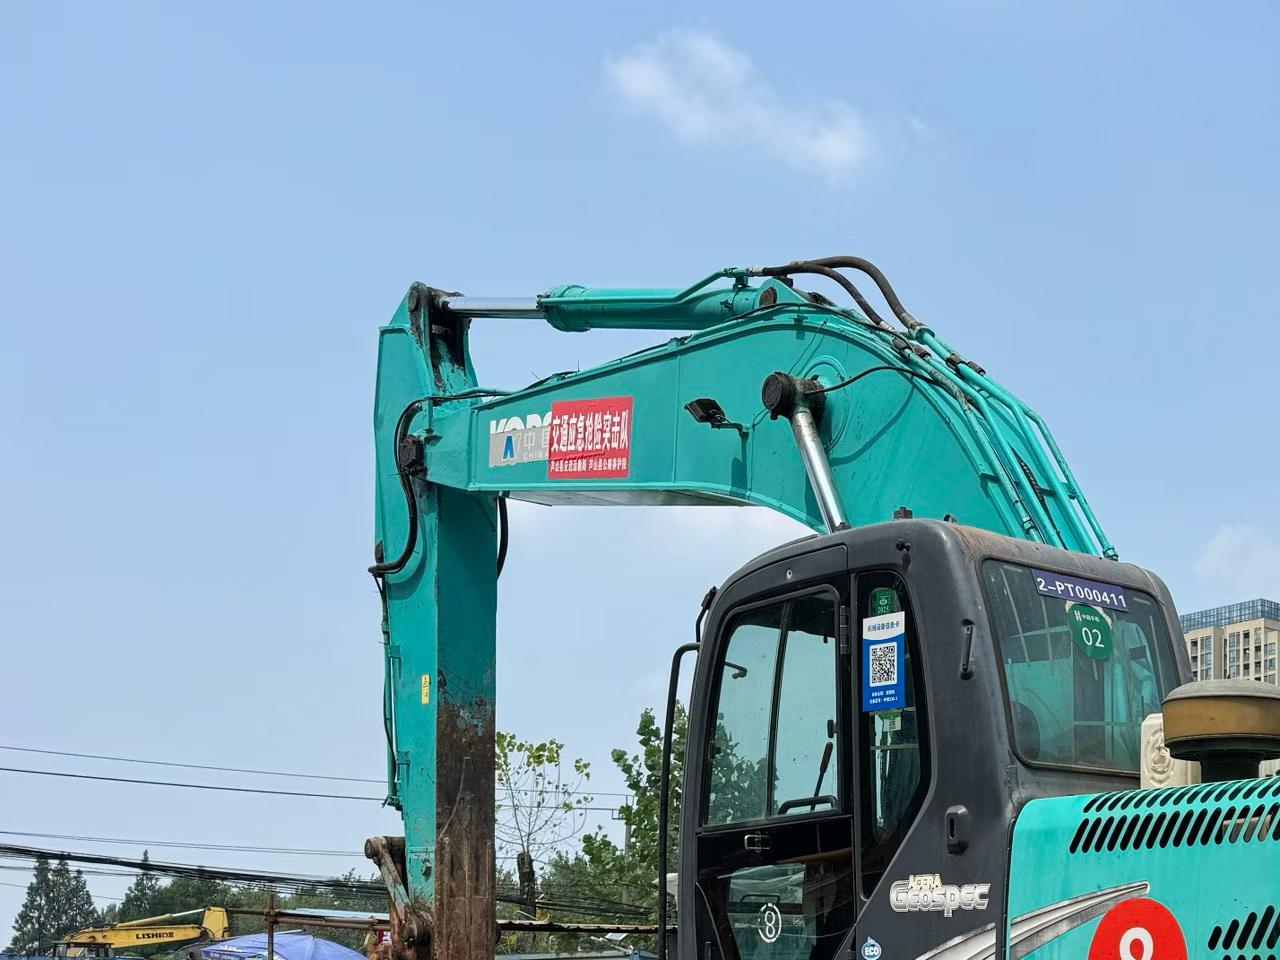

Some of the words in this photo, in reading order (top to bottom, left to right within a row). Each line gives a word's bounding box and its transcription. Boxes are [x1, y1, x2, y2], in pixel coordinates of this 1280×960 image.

[551, 409, 629, 453] 交通应急抢险突击队
[1037, 577, 1127, 608] 2-PT000411
[1081, 627, 1105, 648] 02
[908, 874, 942, 890] ACERA
[864, 945, 879, 956] ECO
